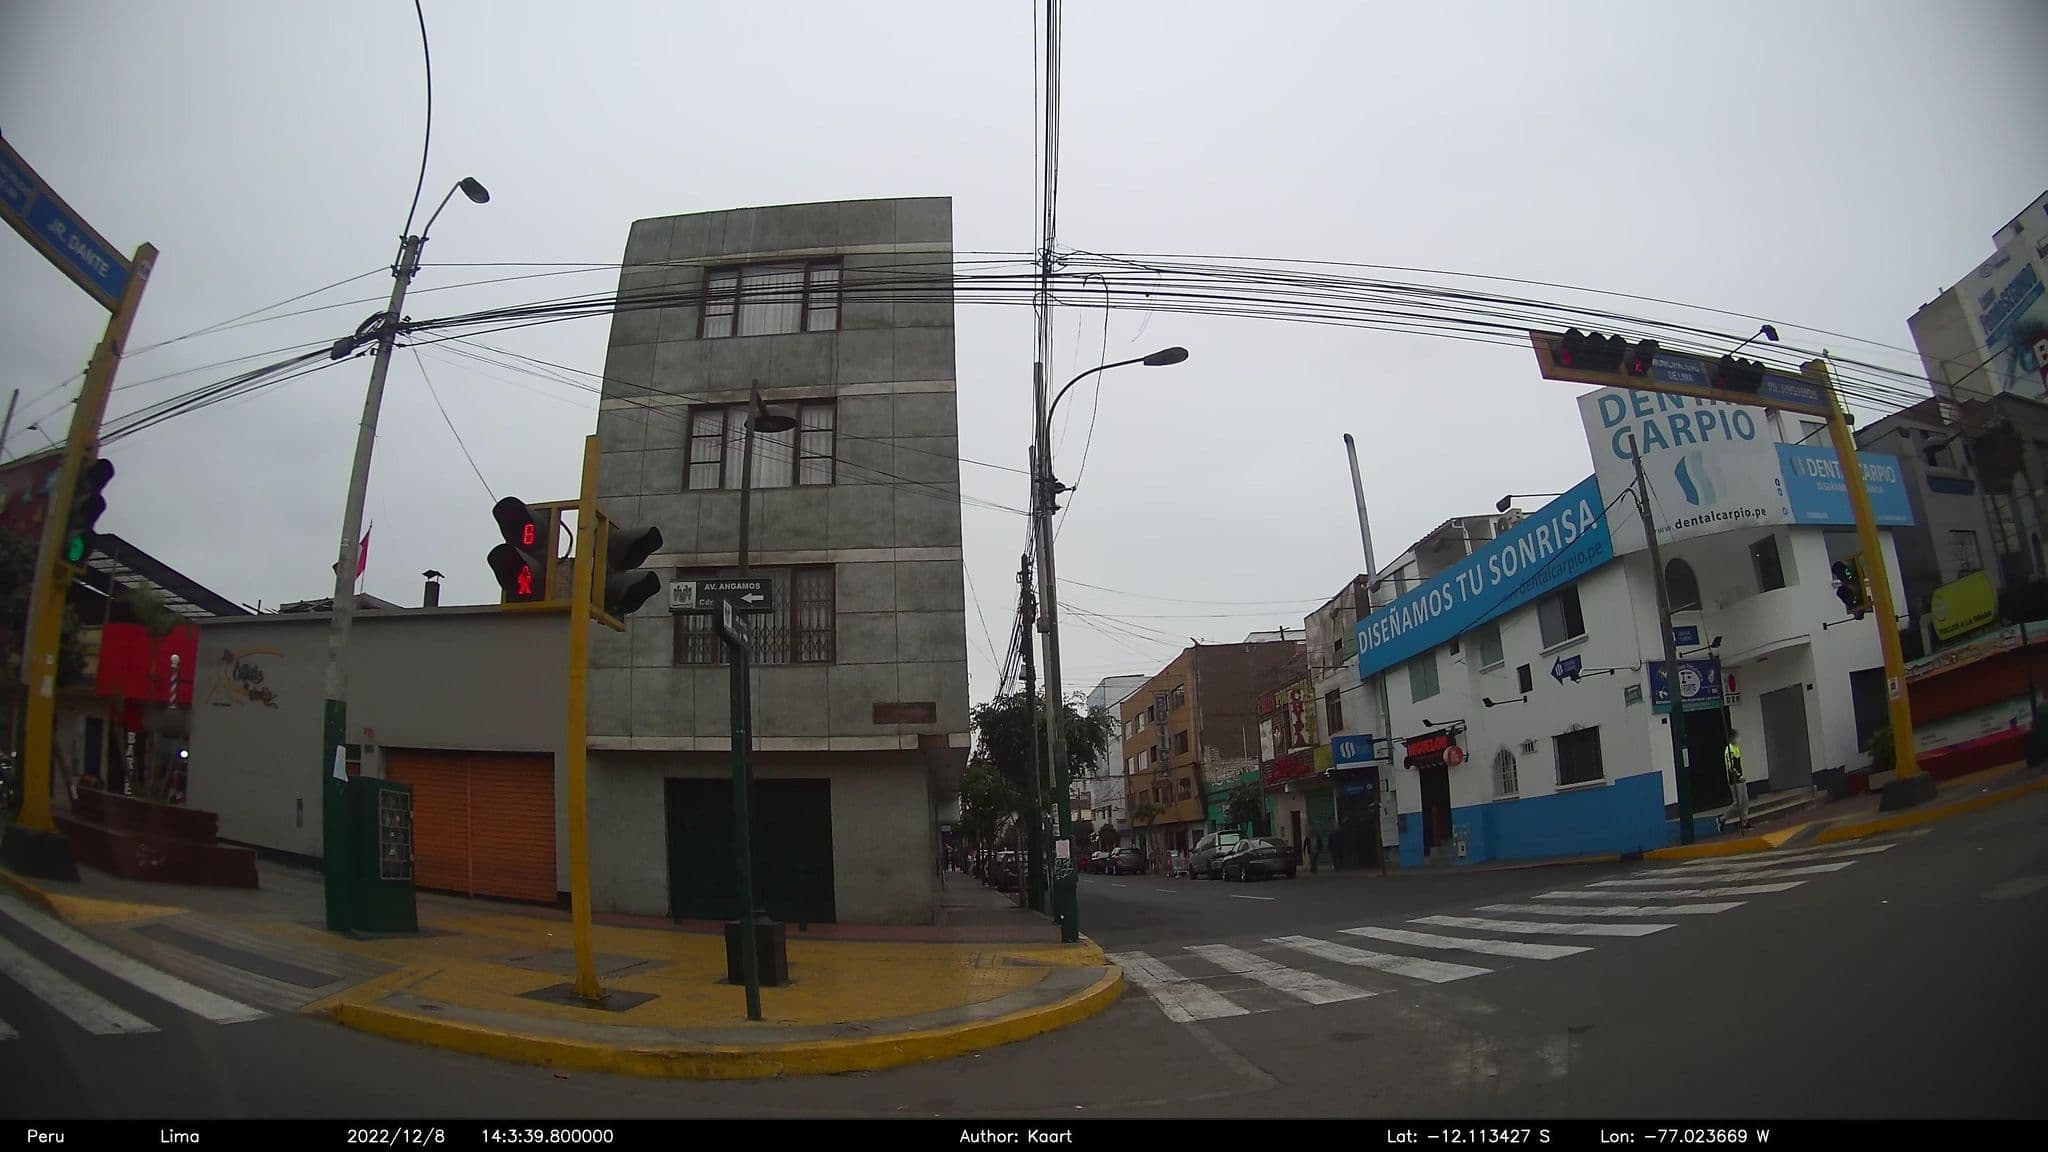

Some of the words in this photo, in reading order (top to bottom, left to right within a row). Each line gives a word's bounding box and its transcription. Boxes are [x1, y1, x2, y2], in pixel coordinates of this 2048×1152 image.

[67, 234, 110, 280] DANTE
[1598, 388, 1736, 428] DEN
[1612, 409, 1755, 460] CARPIO
[1807, 458, 1845, 480] DENT
[1859, 463, 1896, 483] ARPIO
[704, 583, 717, 591] AV.
[719, 582, 761, 590] ANGAMOS
[1357, 582, 1453, 655] DISEÑAMOS
[1456, 564, 1484, 603] TU
[1489, 499, 1598, 586] SONRISA
